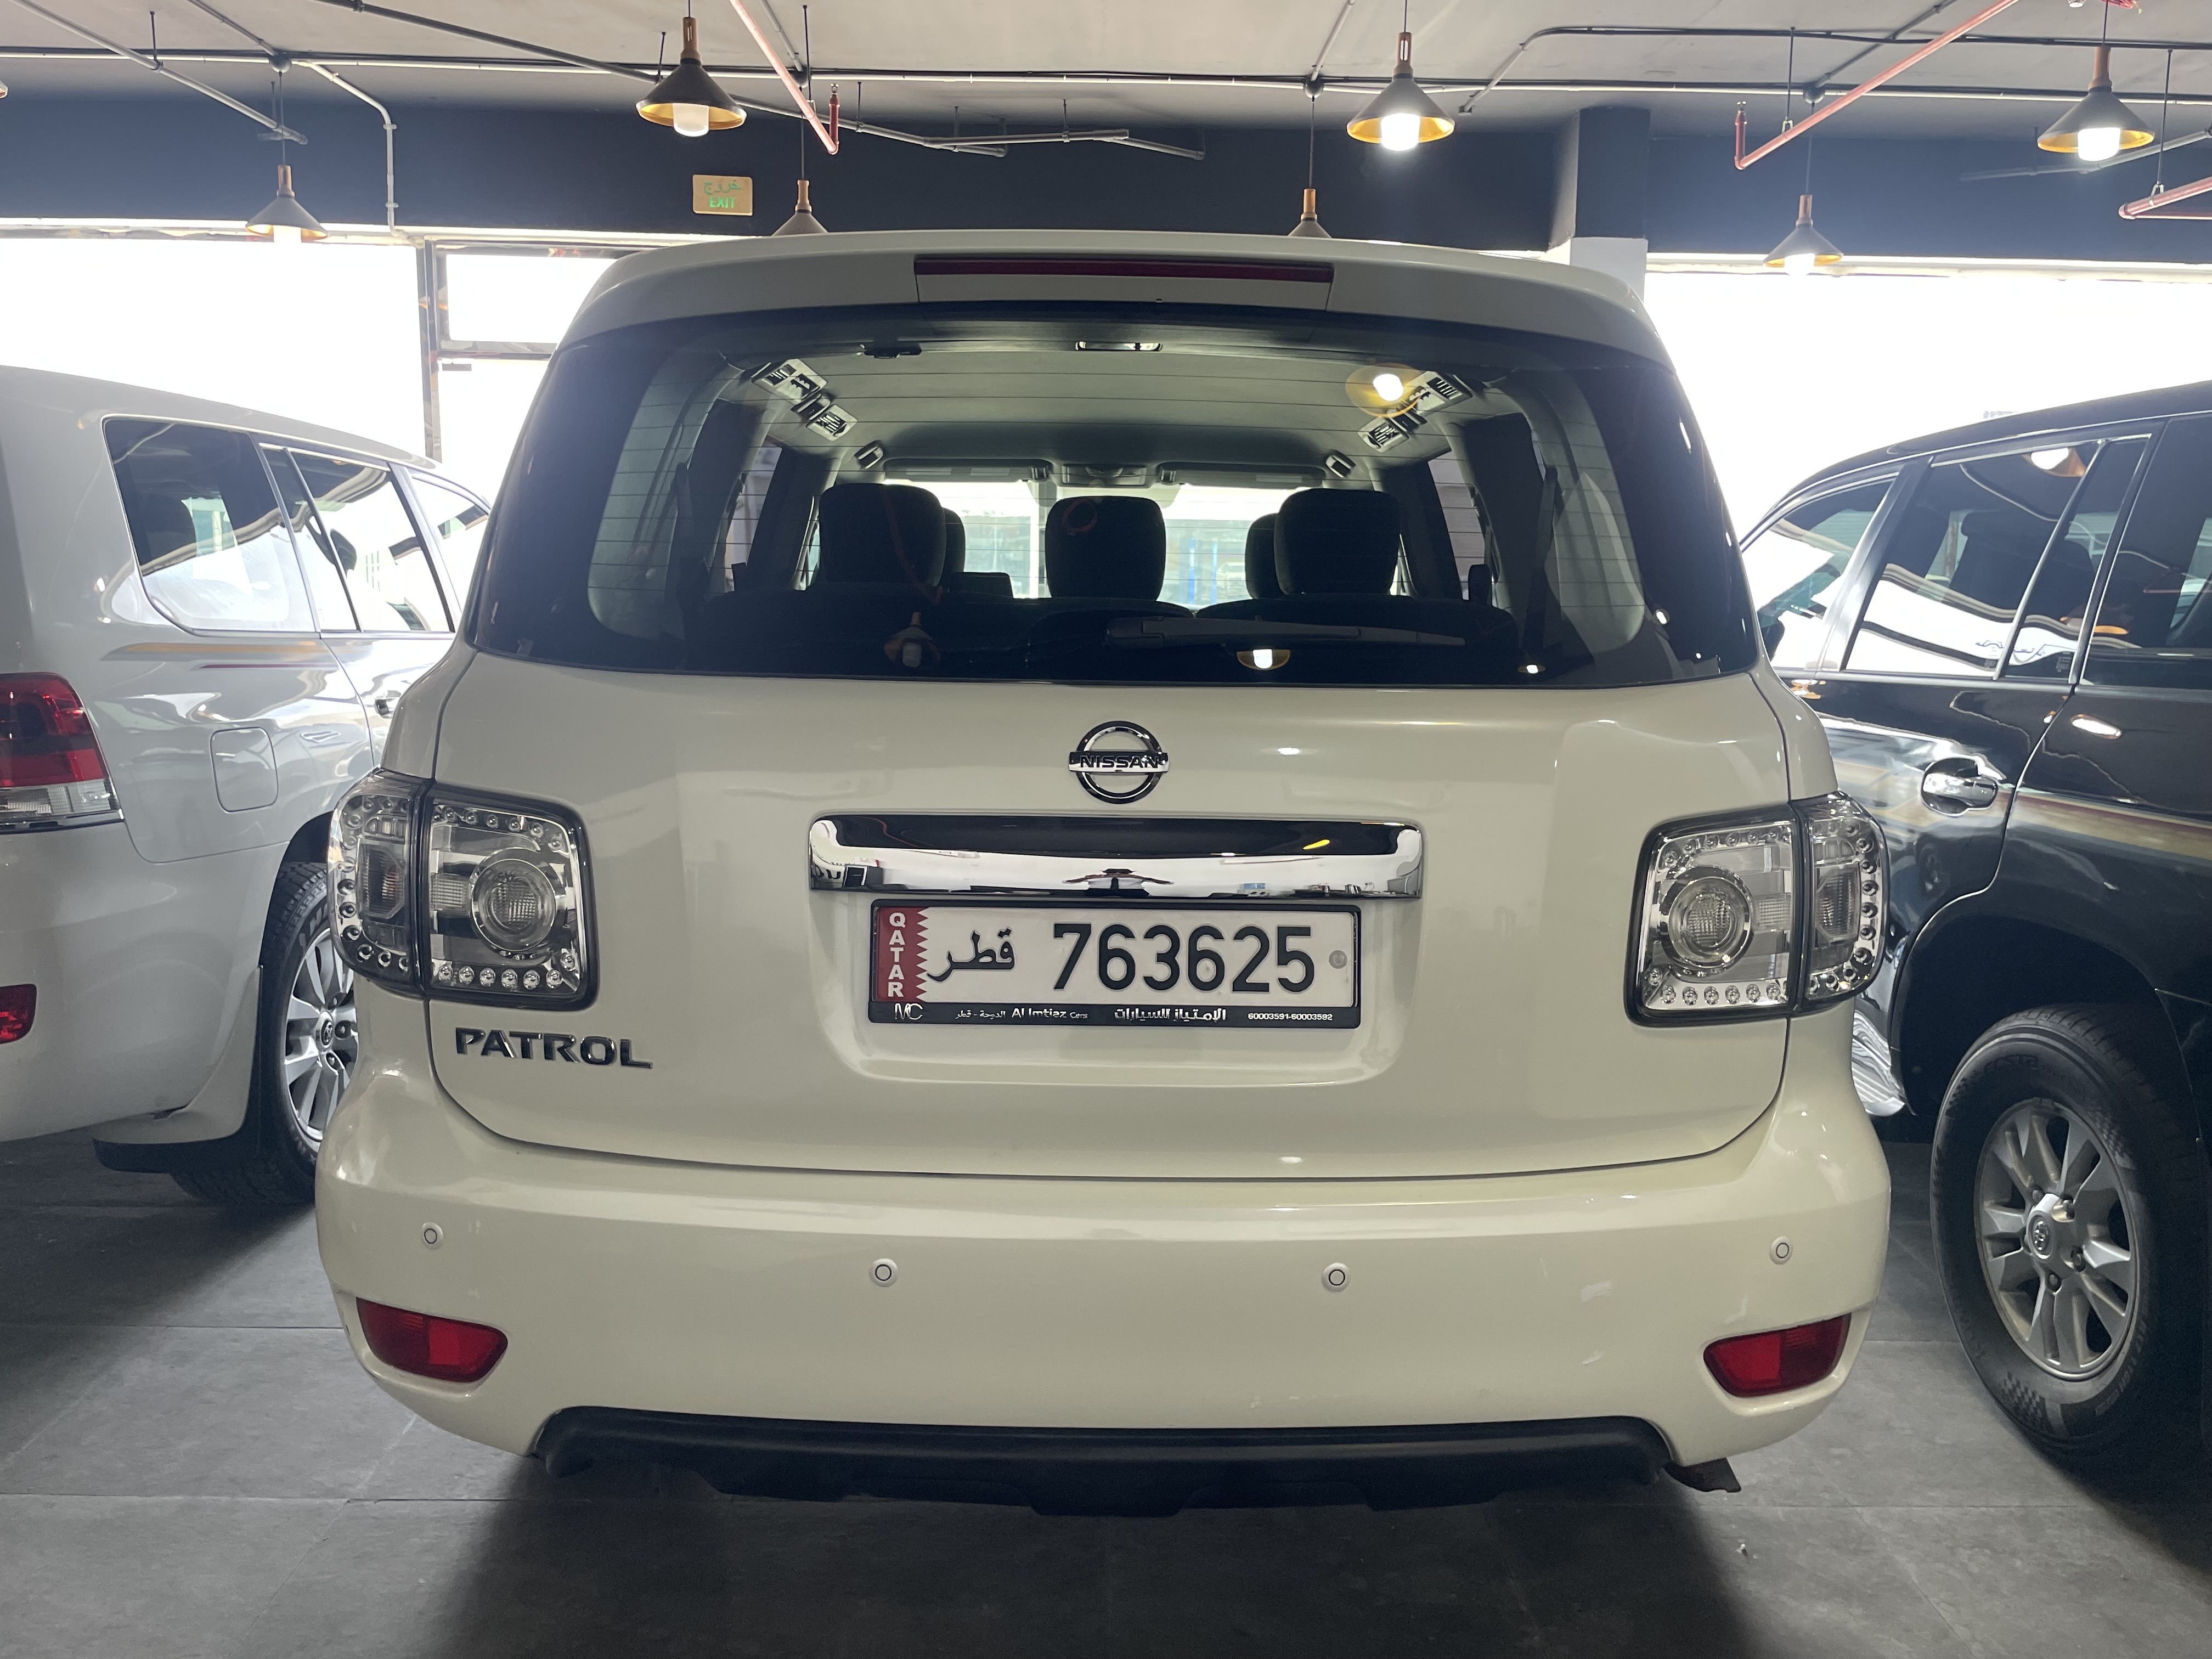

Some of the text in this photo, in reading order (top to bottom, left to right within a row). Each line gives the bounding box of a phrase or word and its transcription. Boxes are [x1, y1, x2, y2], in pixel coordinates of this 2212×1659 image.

[704, 179, 741, 195] خروج
[709, 197, 735, 208] EXIT
[1080, 755, 1159, 769] NISSAN
[888, 912, 906, 997] QATAR
[927, 928, 1014, 981] قطر
[1054, 923, 1314, 992] 763625
[955, 1009, 972, 1019] قطر
[1012, 1008, 1025, 1018] Al
[1029, 1008, 1067, 1019] Imtiaz
[1114, 1008, 1171, 1022] للسيارات
[1248, 1012, 1333, 1021] 60003591-60003592
[455, 1027, 654, 1069] PATROL
